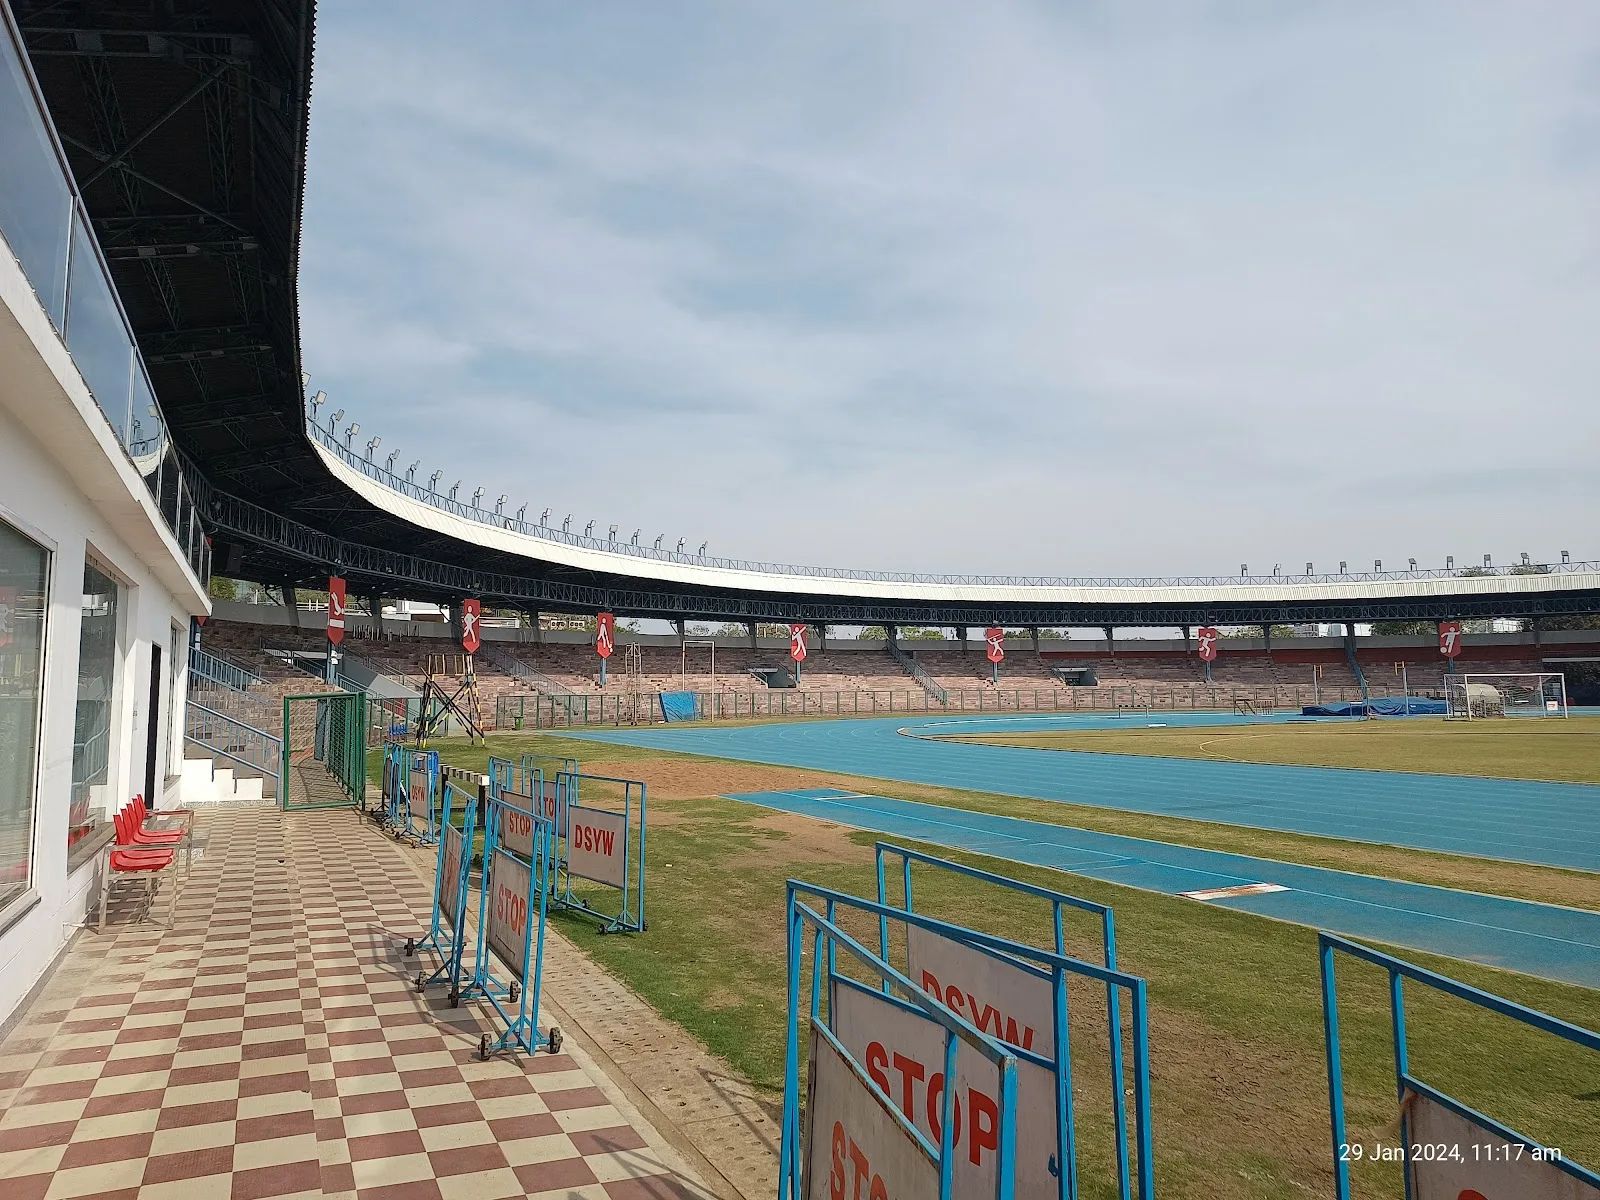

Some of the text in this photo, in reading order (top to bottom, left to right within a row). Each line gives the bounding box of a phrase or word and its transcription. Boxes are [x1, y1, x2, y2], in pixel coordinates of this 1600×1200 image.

[509, 811, 531, 837] STOP
[574, 824, 615, 857] DSYW
[497, 883, 527, 937] STOP
[865, 1041, 999, 1167] STOP
